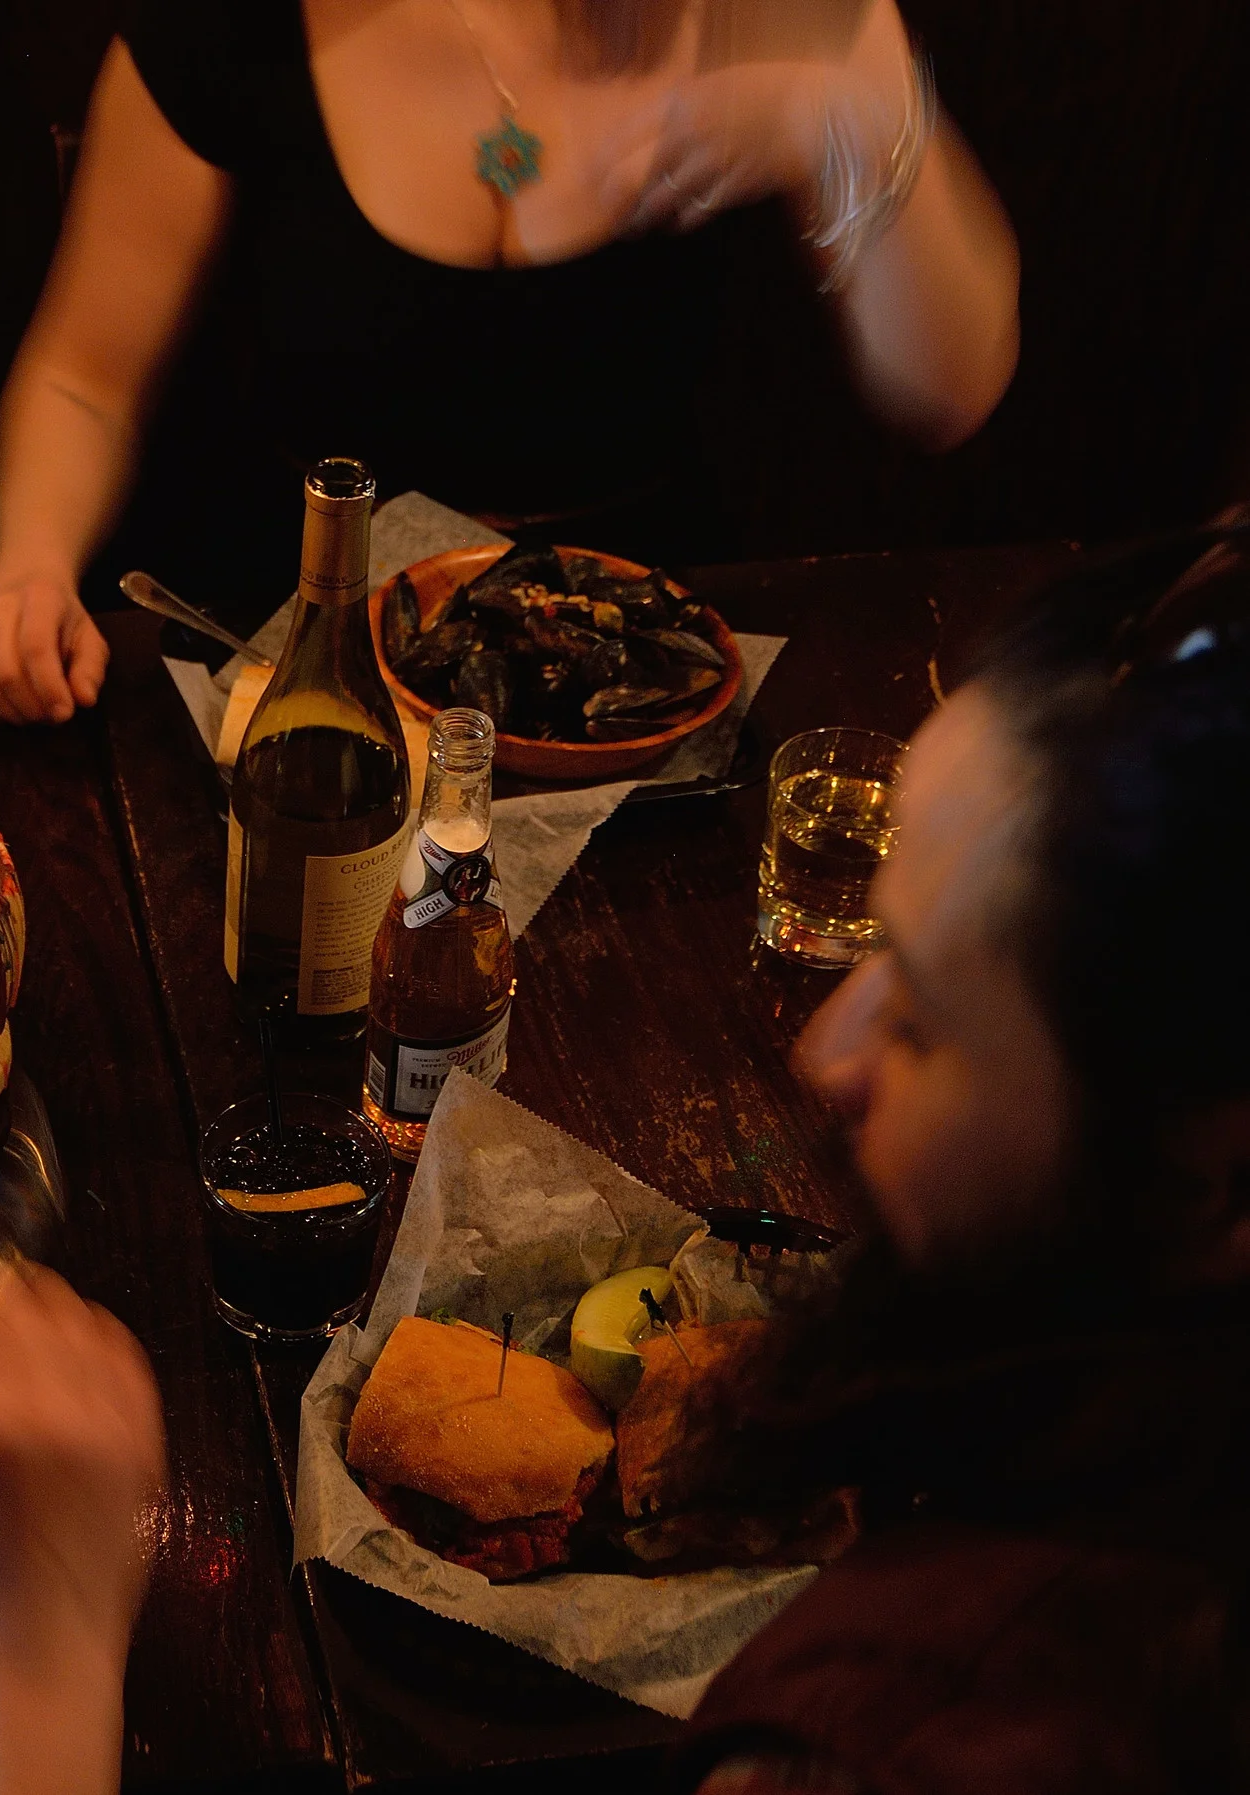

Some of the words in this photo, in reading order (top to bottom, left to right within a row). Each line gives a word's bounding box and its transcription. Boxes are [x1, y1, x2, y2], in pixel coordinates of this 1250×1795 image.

[423, 840, 447, 862] Miller
[340, 851, 389, 875] CLOUD
[414, 898, 445, 919] HIGH
[447, 1034, 492, 1067] Miller
